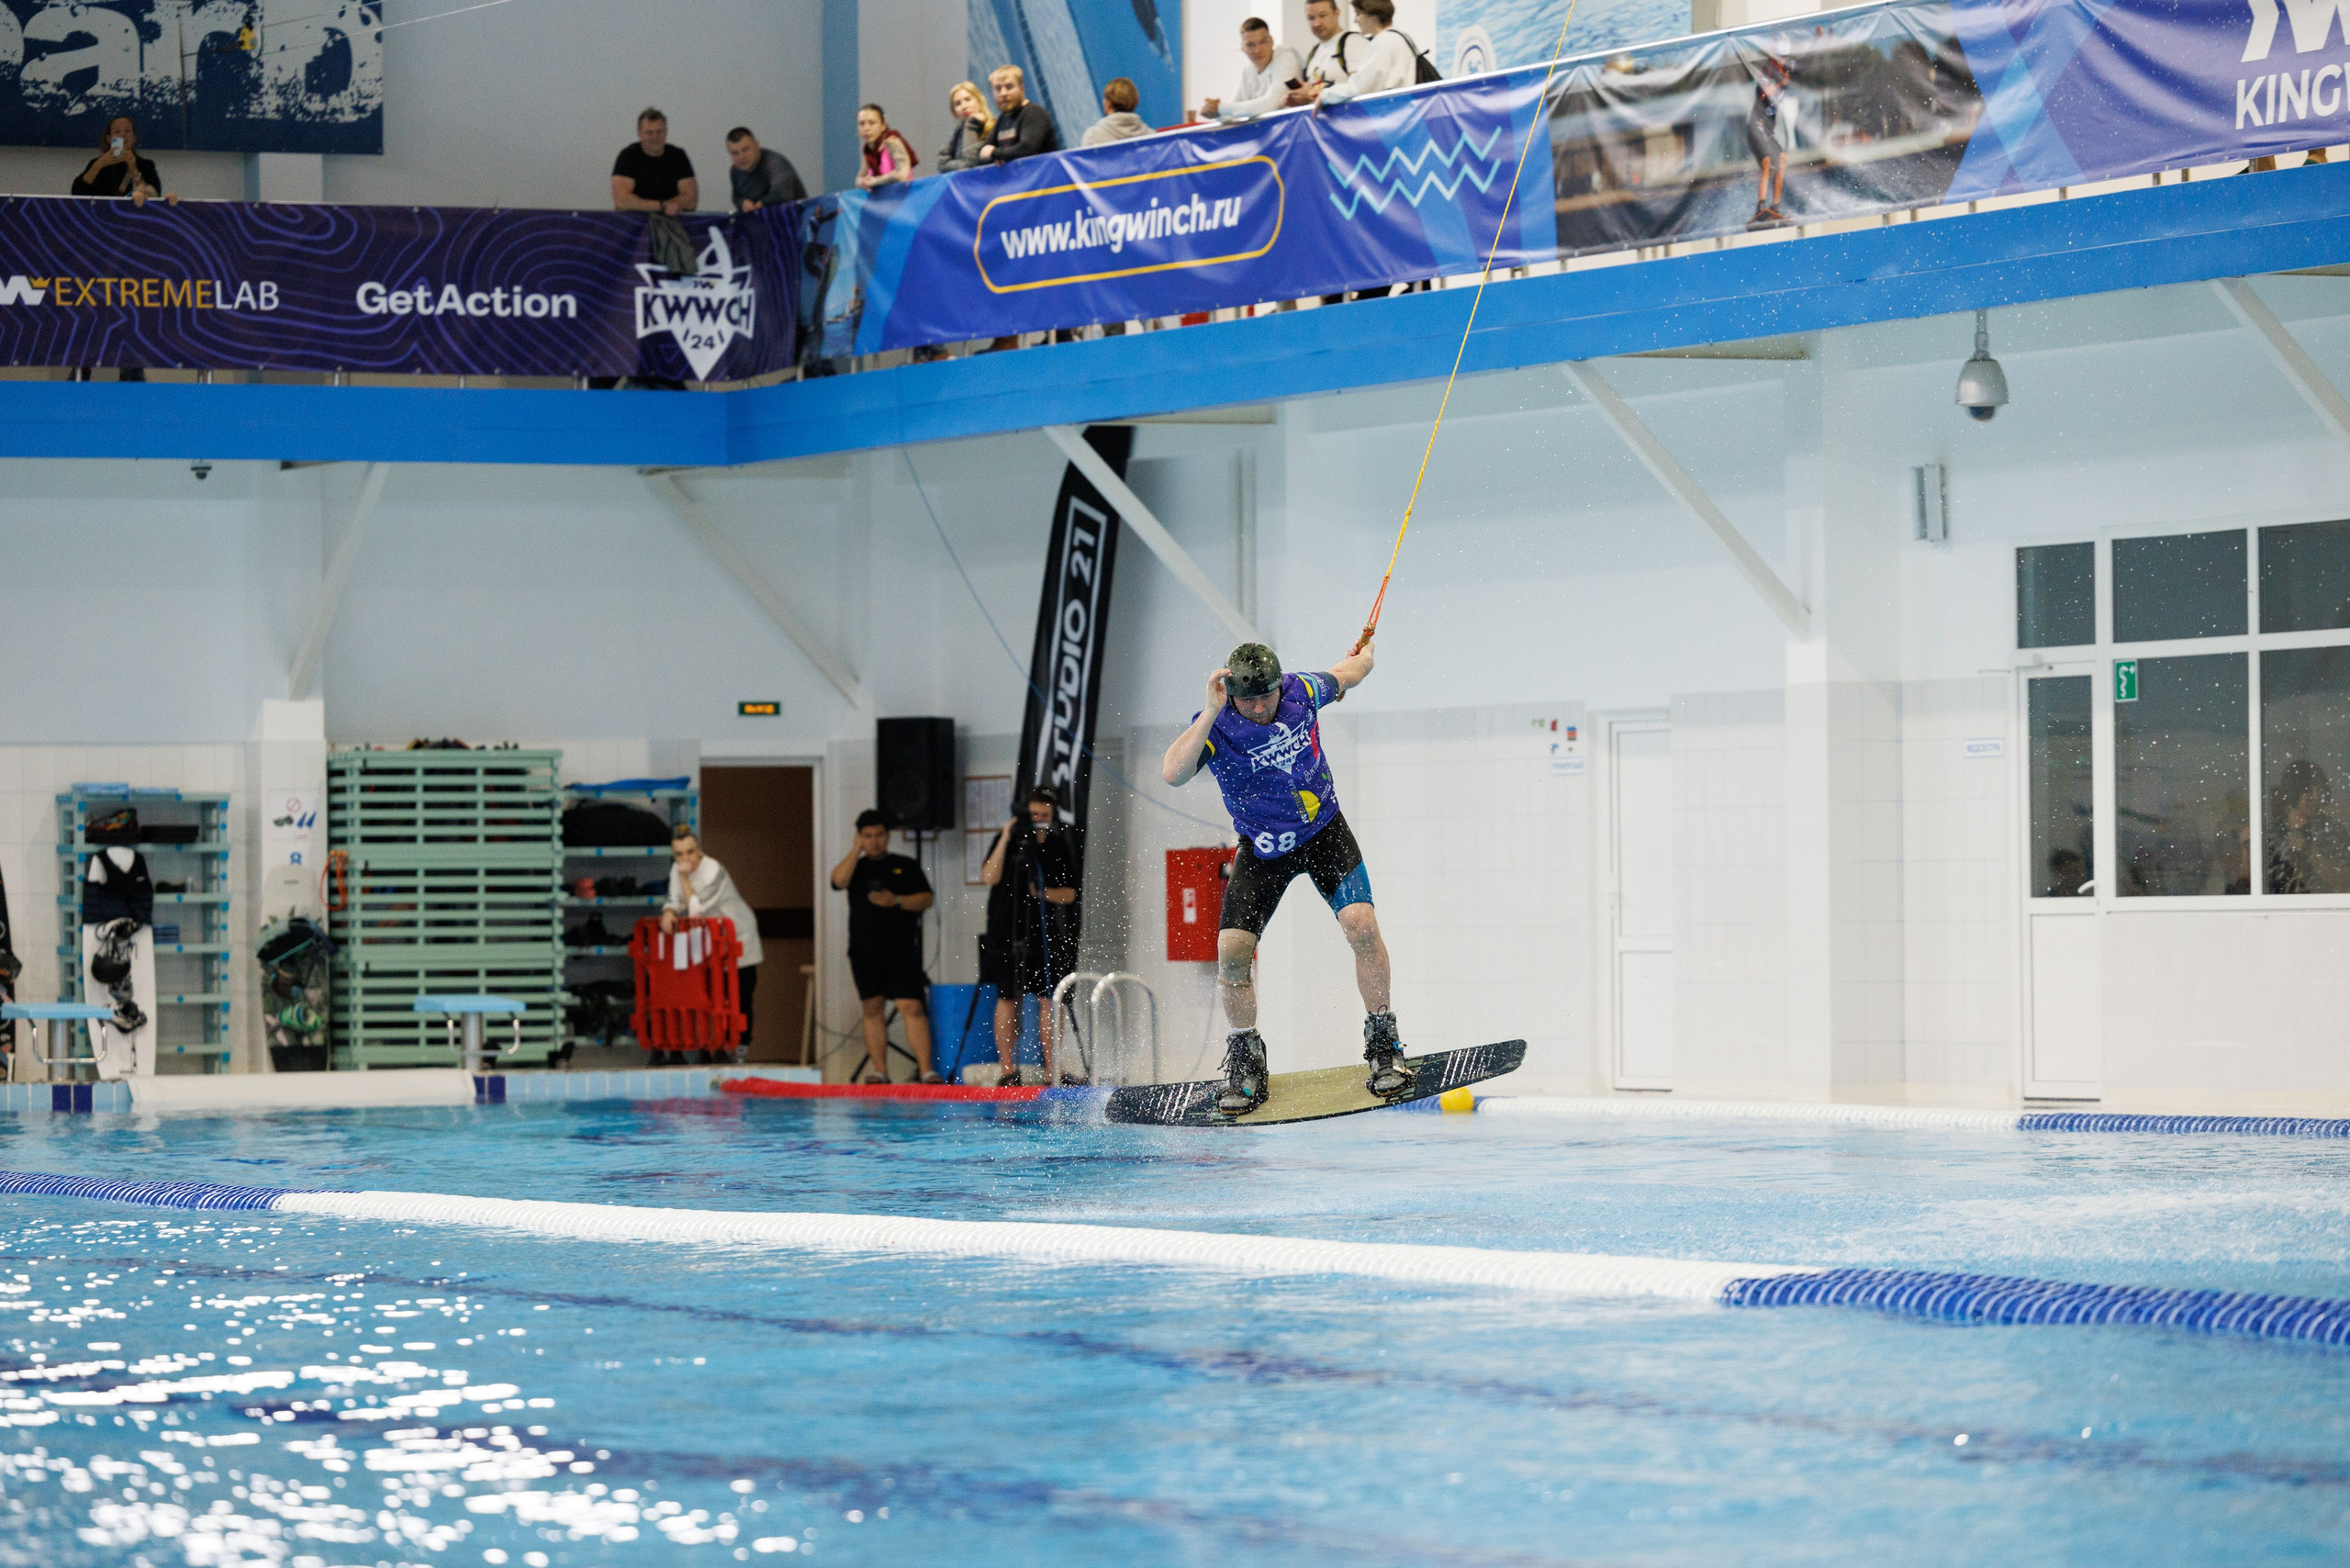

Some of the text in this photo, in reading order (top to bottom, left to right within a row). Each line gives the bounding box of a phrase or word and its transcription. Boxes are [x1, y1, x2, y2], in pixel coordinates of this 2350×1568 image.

[2235, 62, 2350, 129] KING
[1001, 193, 1241, 259] www.kingwinch.ru
[55, 277, 279, 310] EXTREMELAB
[356, 281, 577, 319] GetAction
[643, 292, 752, 329] KWWCH
[1070, 526, 1096, 586] 21
[1254, 731, 1311, 768] KWWCH
[1255, 831, 1296, 854] 68
